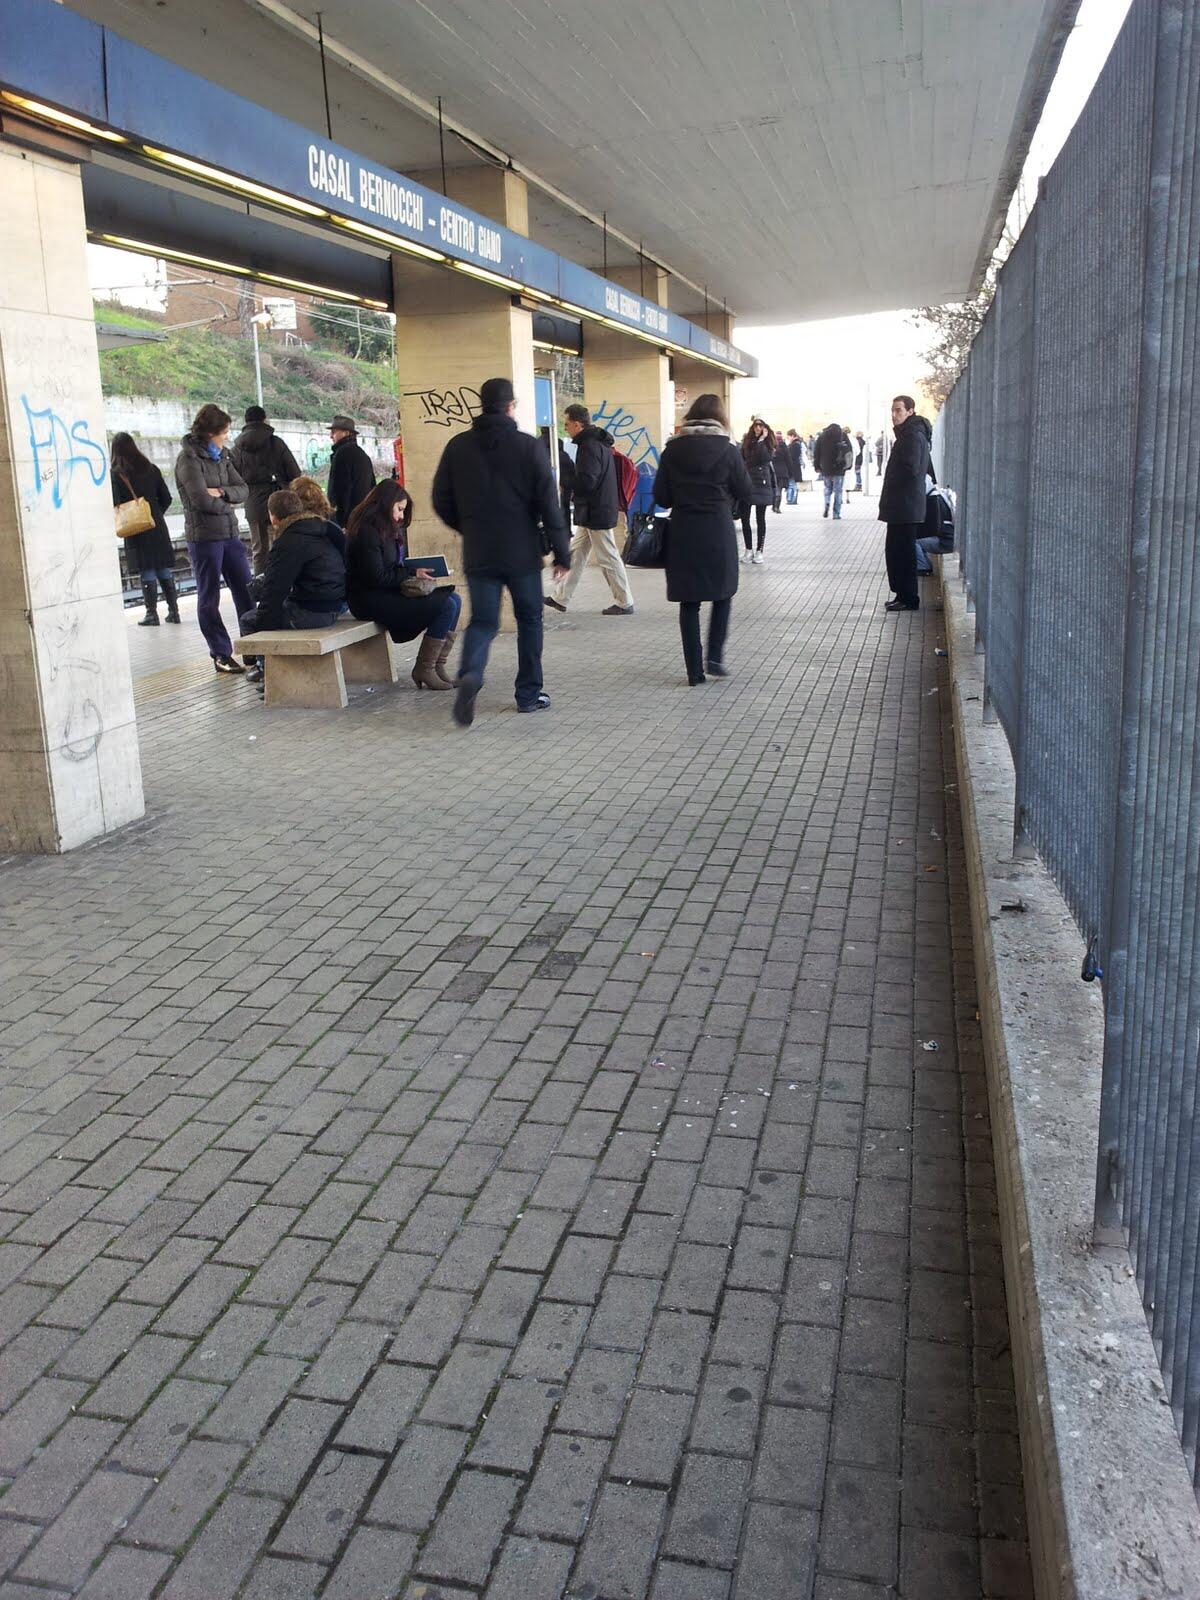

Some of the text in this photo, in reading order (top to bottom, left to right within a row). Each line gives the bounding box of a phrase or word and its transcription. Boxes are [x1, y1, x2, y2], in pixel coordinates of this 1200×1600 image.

[308, 145, 354, 204] CASAL
[359, 168, 424, 232] BERNOCCHI
[440, 207, 475, 254] CENTRO
[478, 225, 501, 264] GIANO
